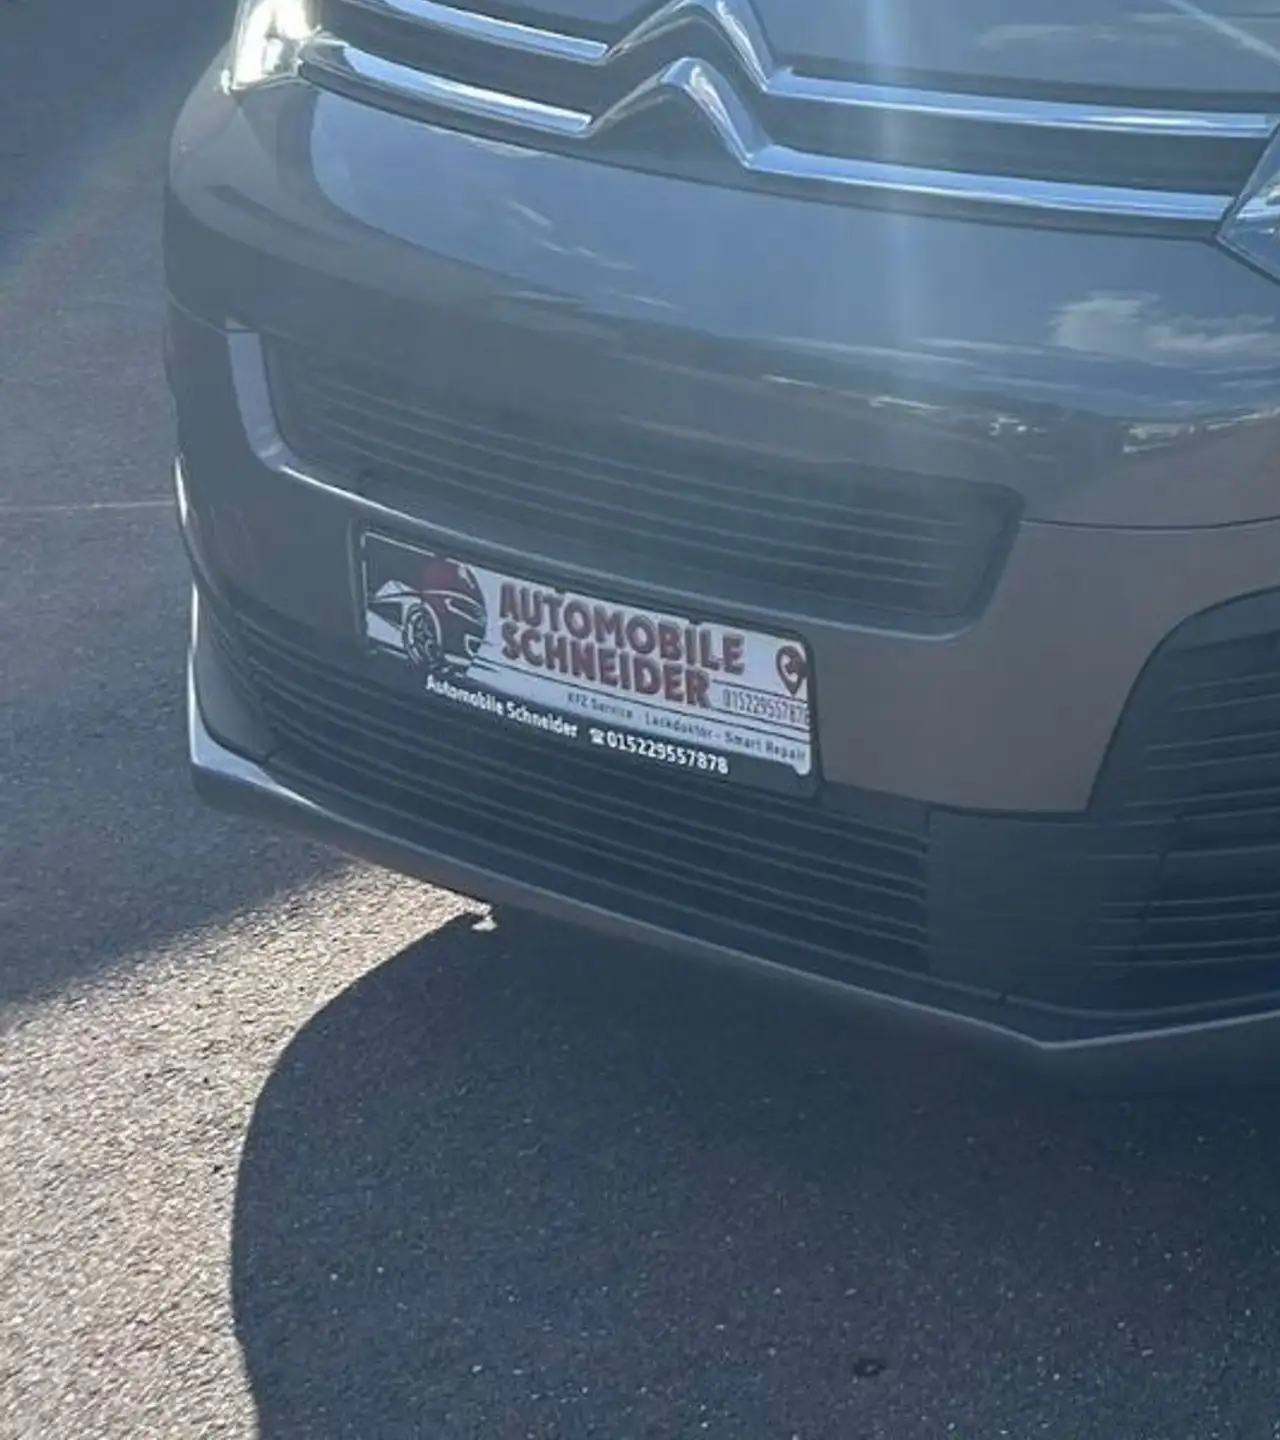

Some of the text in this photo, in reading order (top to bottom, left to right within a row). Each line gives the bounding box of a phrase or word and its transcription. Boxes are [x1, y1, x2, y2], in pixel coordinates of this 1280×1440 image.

[500, 582, 746, 675] AUTOMOBILE
[500, 622, 712, 707] SCHNEIDER
[425, 673, 730, 775] Automobile Schneider 015229557878
[591, 697, 634, 721] Service
[644, 712, 714, 740] Lackdoktor
[723, 730, 763, 754] Smart
[764, 739, 807, 763] Repair
